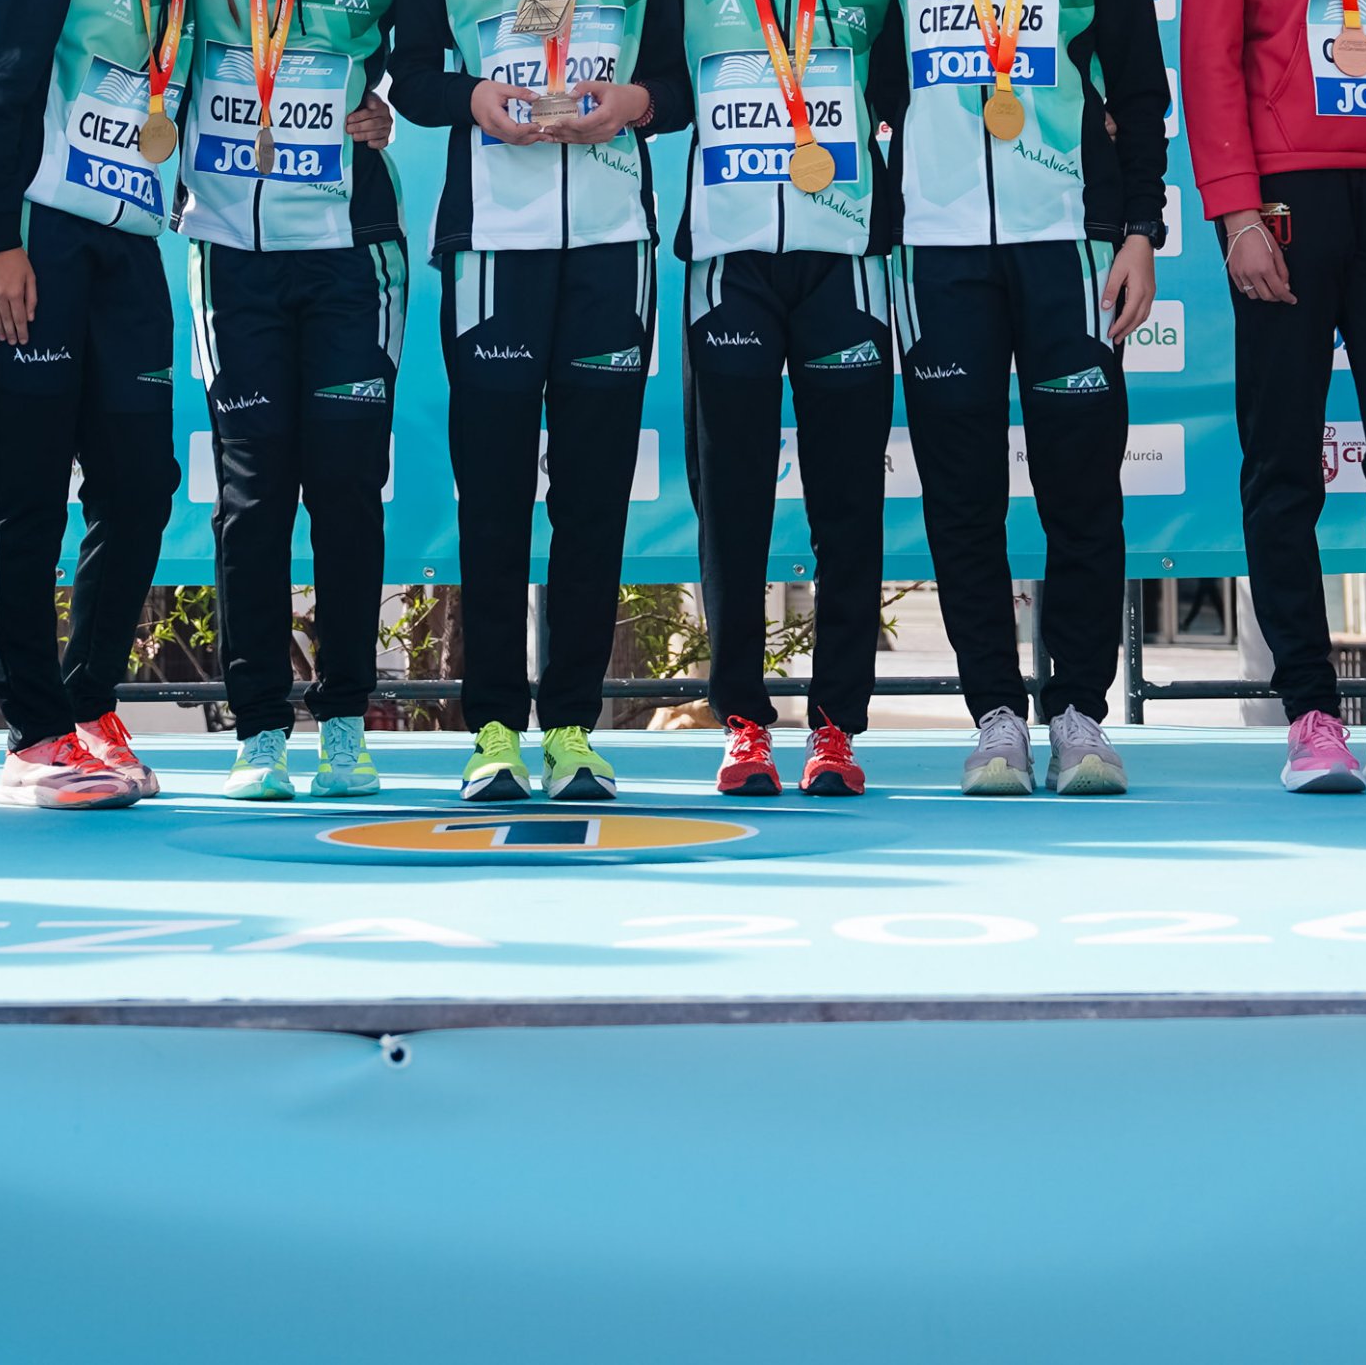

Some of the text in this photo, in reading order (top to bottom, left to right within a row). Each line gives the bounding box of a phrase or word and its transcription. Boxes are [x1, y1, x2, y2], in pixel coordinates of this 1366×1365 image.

[79, 110, 142, 151] CIEZA
[279, 102, 333, 130] 2026
[712, 101, 781, 131] CIEZA
